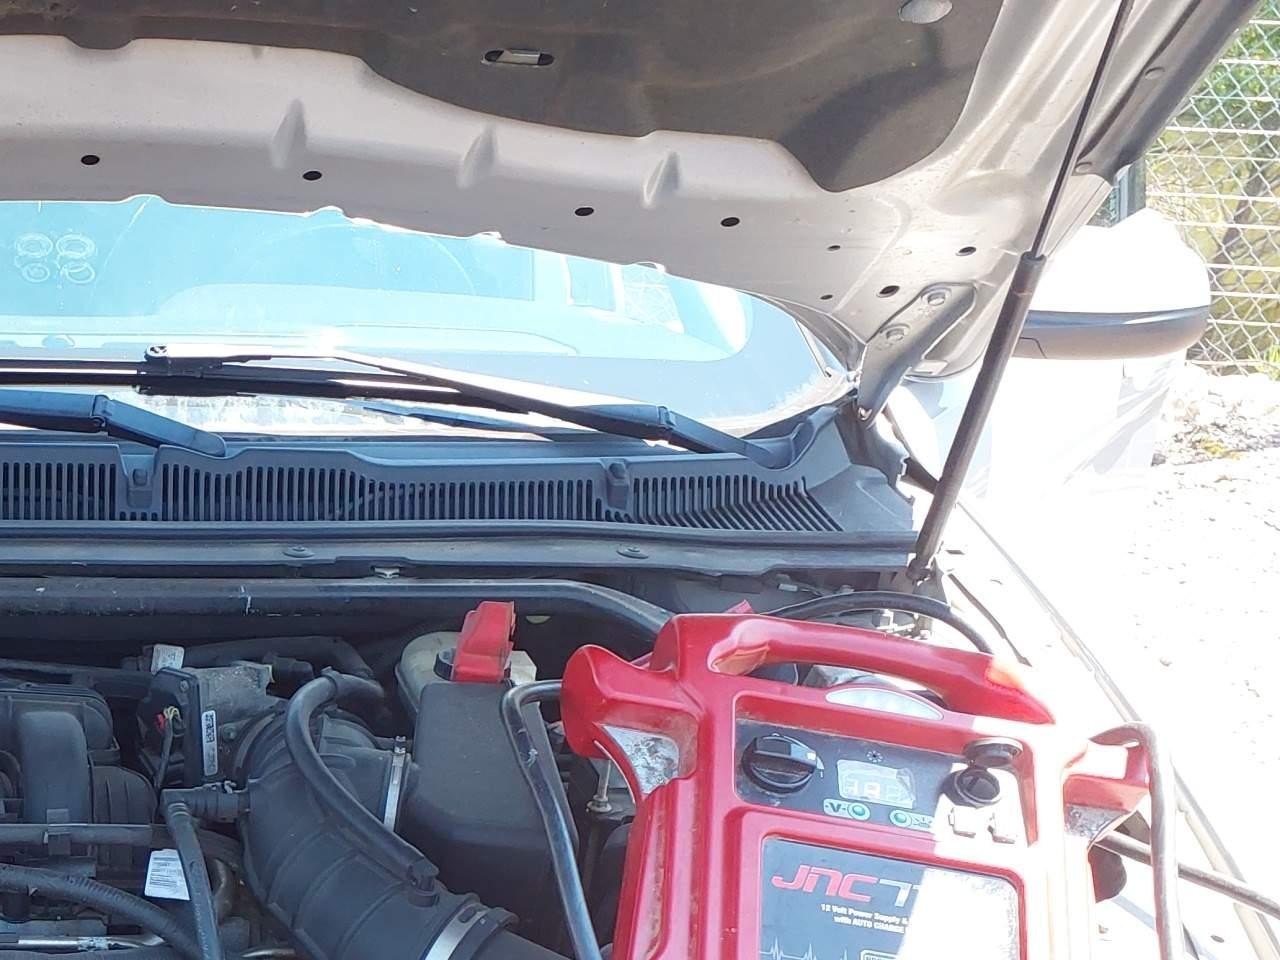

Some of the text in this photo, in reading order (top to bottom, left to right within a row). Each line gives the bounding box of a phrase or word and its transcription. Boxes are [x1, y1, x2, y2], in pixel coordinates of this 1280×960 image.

[820, 903, 831, 912] 12
[832, 905, 847, 914] Volt
[848, 907, 873, 918] Power
[874, 912, 901, 924] Supply
[852, 918, 873, 928] AUTO
